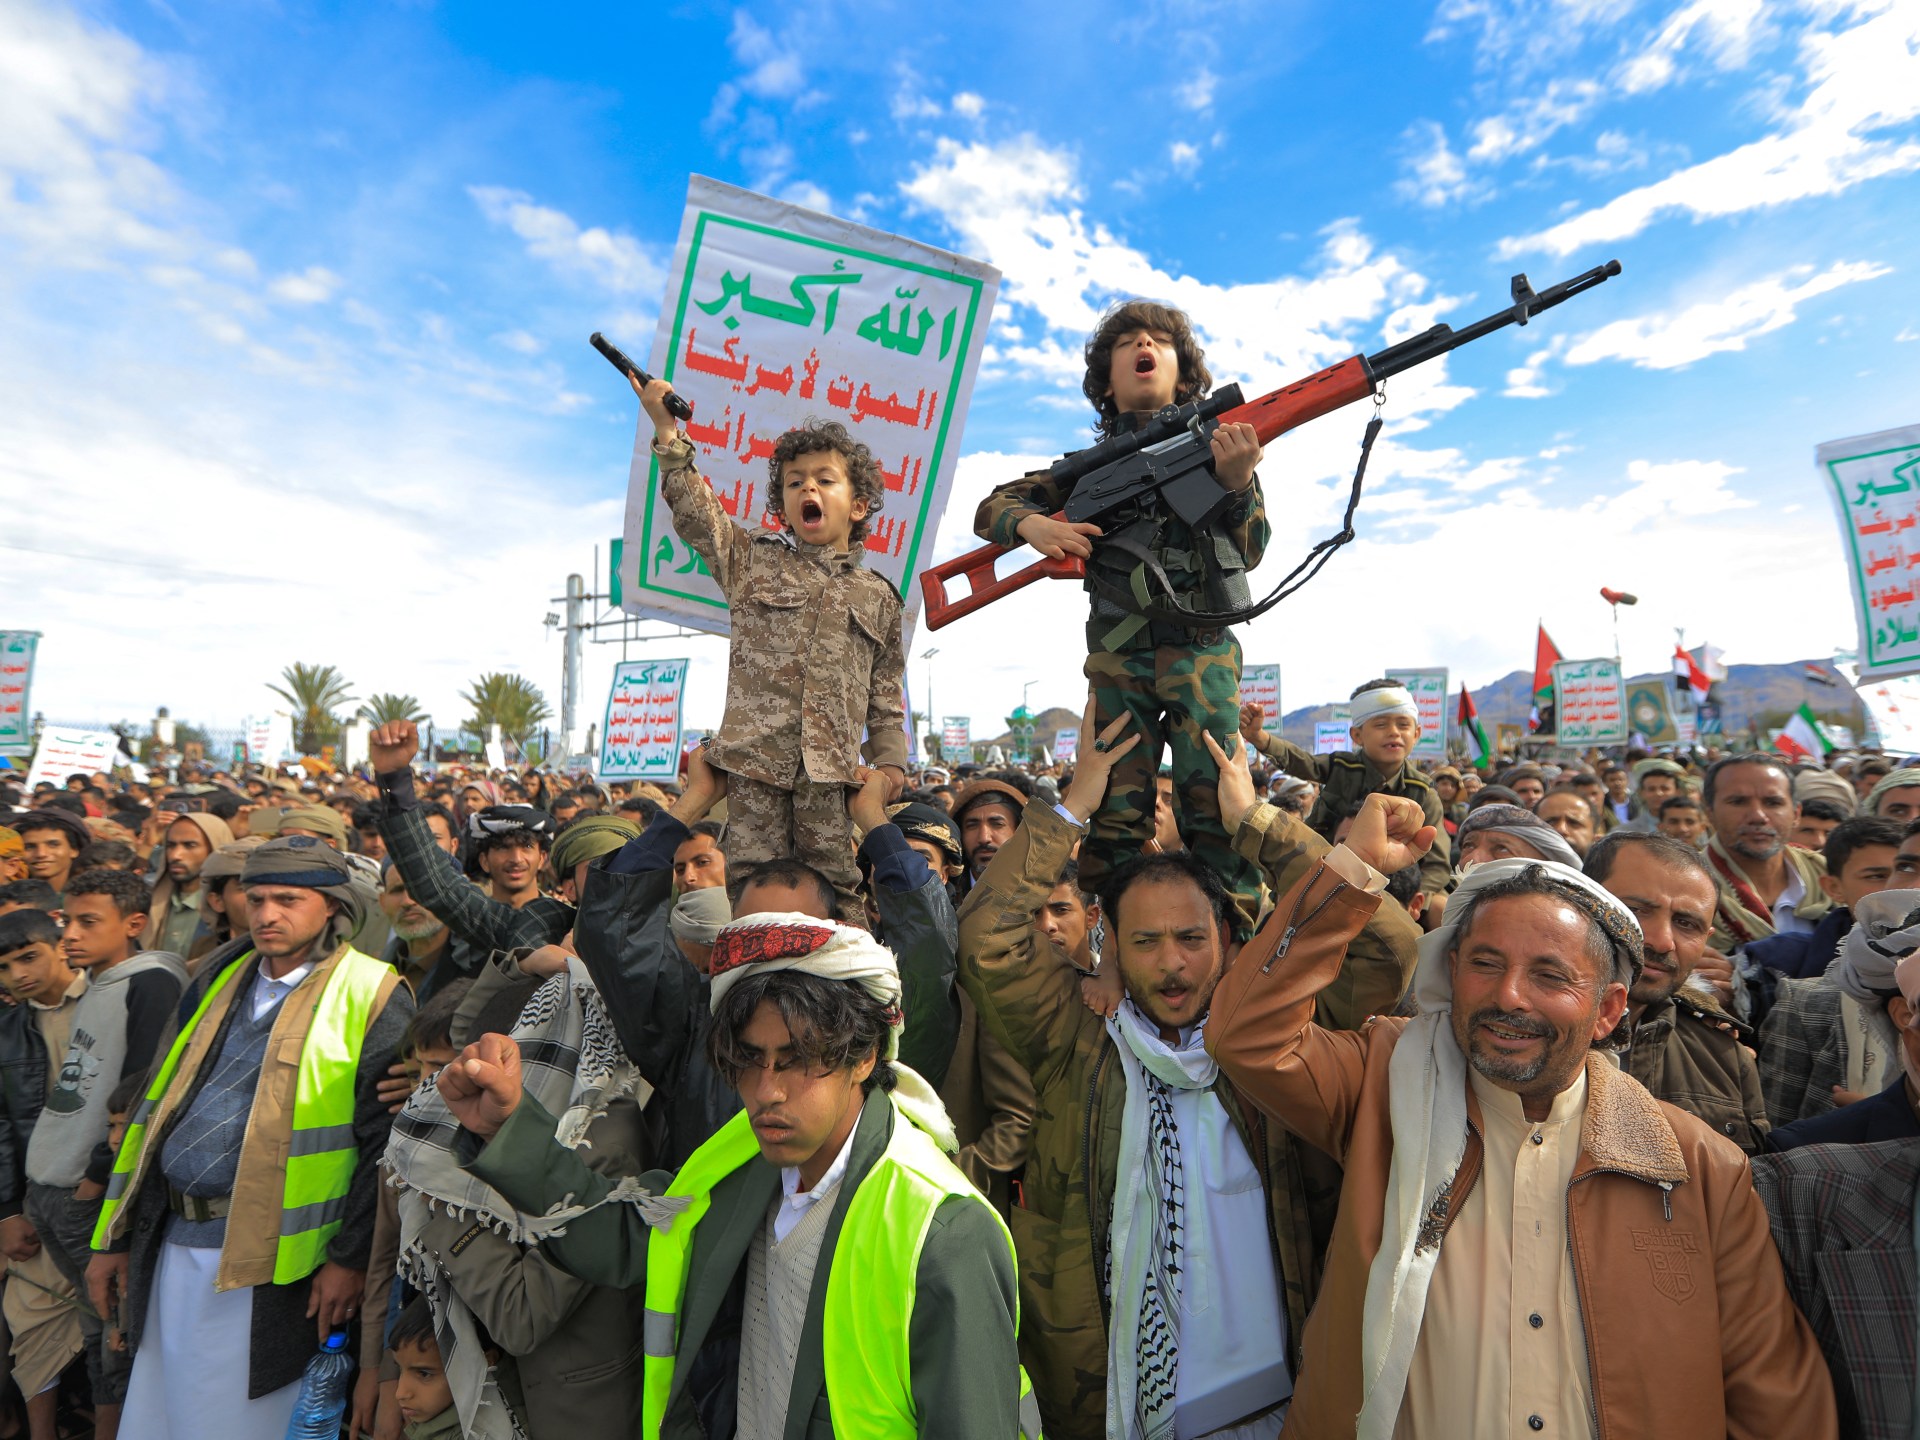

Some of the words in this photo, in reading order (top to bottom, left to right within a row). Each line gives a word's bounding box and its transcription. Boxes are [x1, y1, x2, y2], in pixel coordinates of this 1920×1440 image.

[694, 259, 863, 335] أكبر
[857, 286, 957, 362] الله
[685, 327, 820, 399] لأمريكا
[826, 374, 938, 431] الموت
[617, 664, 658, 690] أكبر
[658, 665, 683, 683] الله
[650, 710, 677, 726] الموت
[652, 690, 679, 706] الموت
